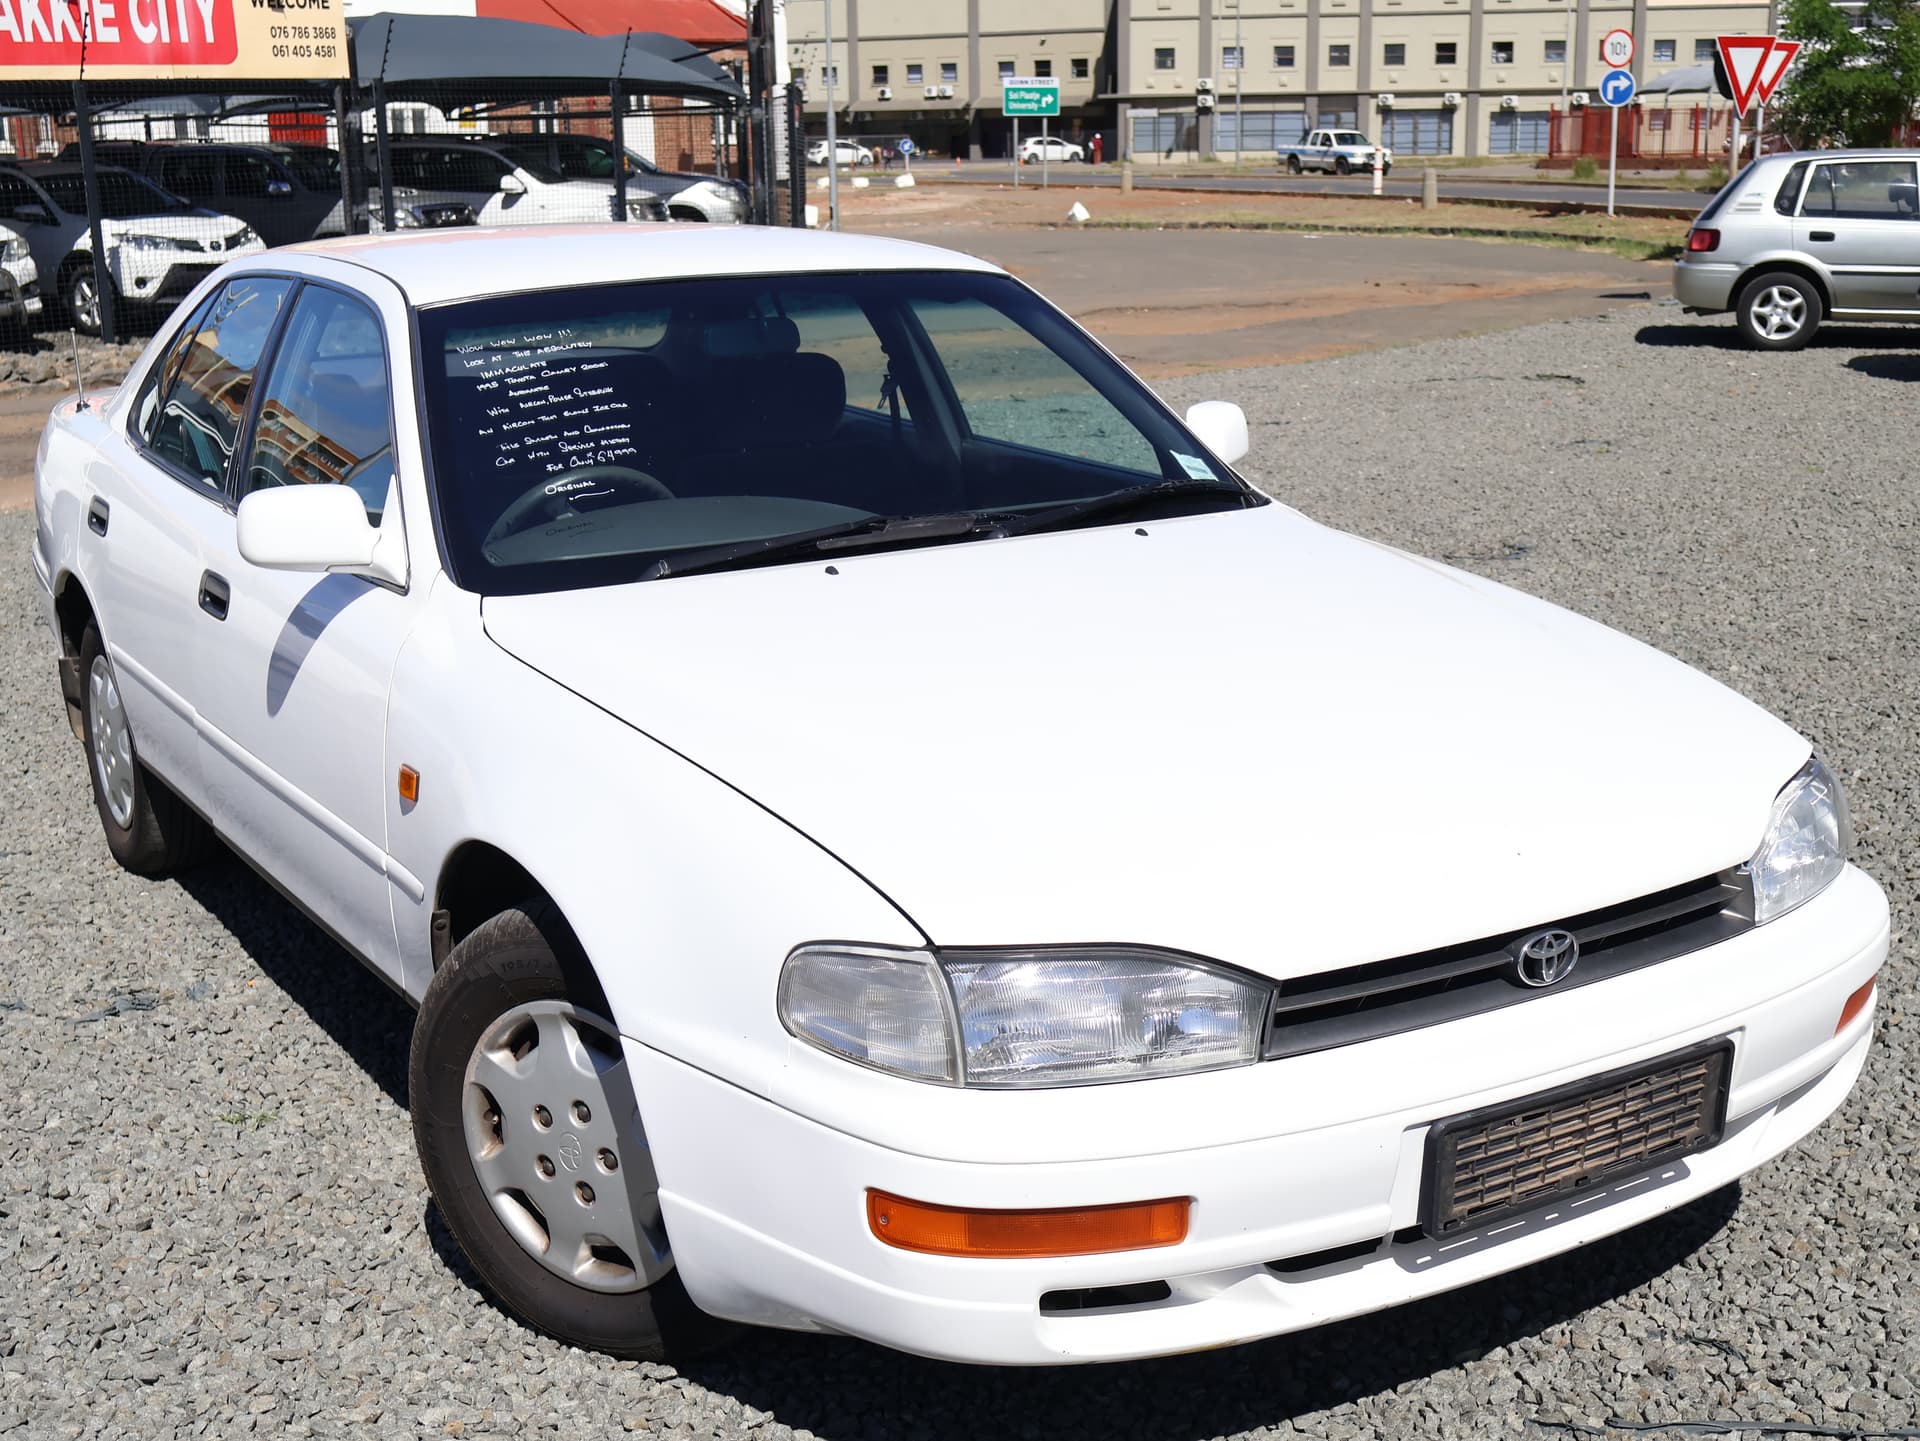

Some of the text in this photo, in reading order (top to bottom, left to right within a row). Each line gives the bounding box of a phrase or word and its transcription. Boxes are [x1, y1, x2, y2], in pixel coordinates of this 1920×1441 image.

[251, 0, 330, 9] WELCOME
[128, 0, 215, 44] CITY
[270, 26, 336, 39] 076 786 3868
[272, 45, 336, 58] 061 405 4581
[1610, 42, 1627, 56] 10t
[456, 344, 484, 354] WOW
[490, 338, 516, 347] WOW
[524, 333, 552, 342] WOW
[464, 359, 485, 368] LOOK
[491, 354, 502, 363] AT
[512, 350, 531, 358] THE
[480, 360, 547, 379] IMMACULATE
[544, 480, 596, 495] ORIGINAL
